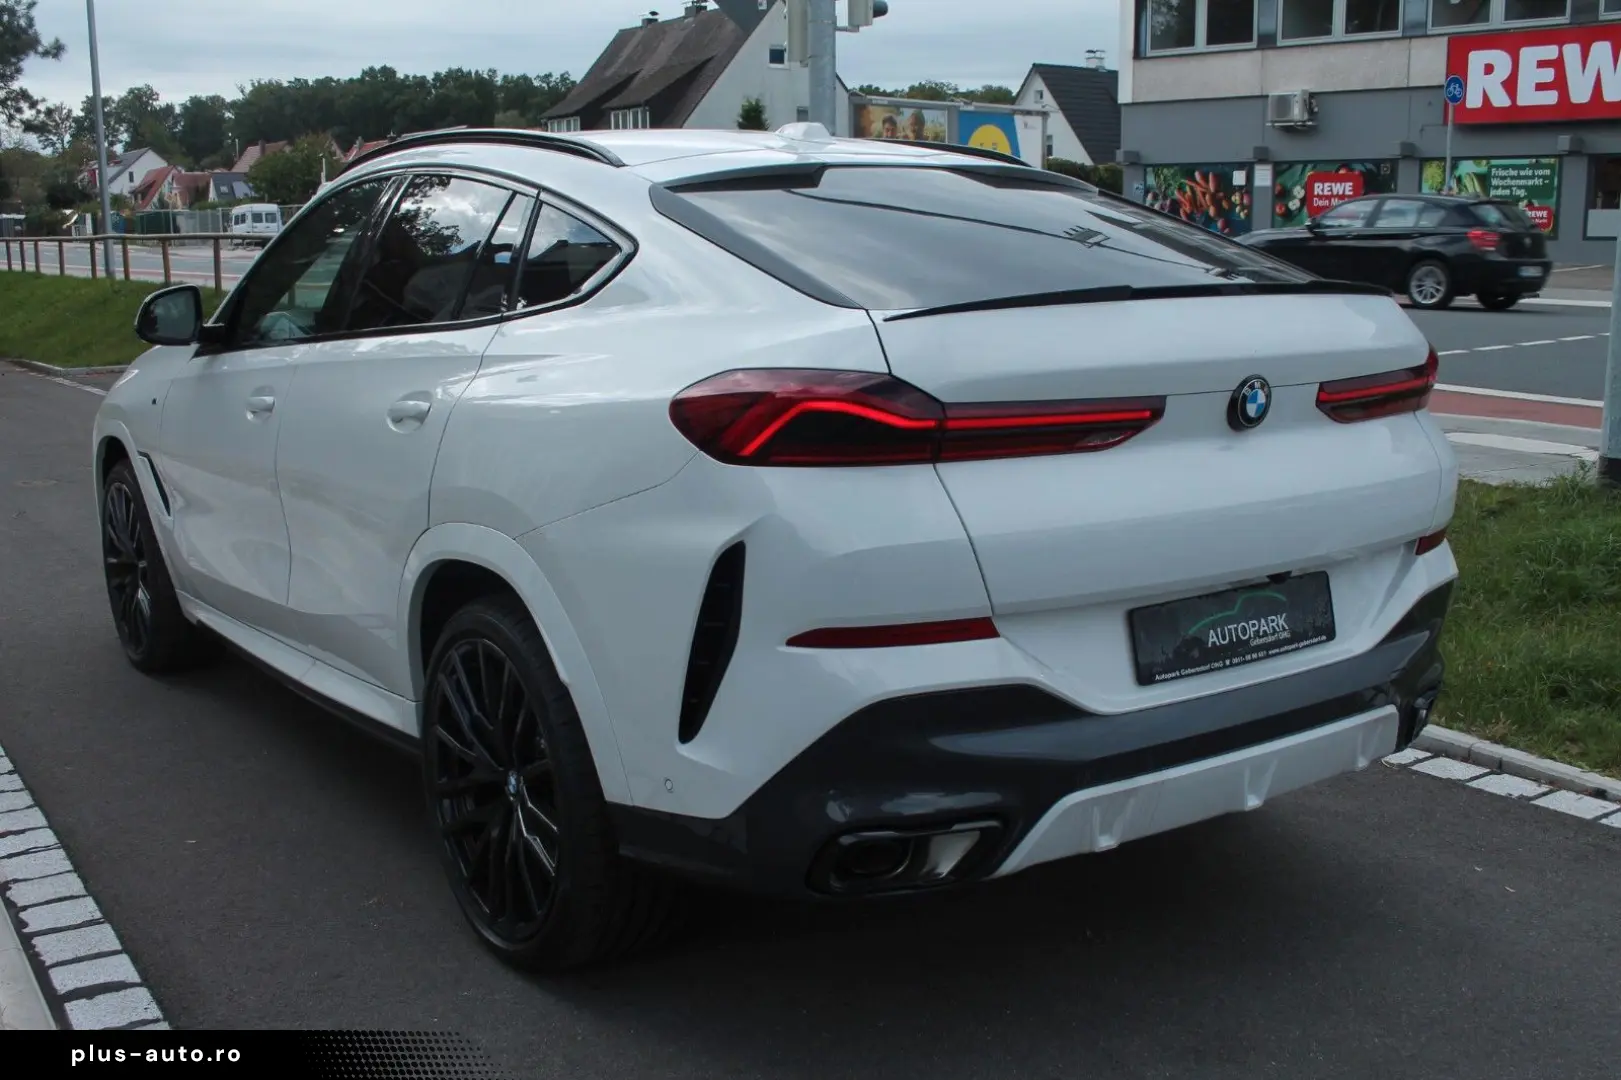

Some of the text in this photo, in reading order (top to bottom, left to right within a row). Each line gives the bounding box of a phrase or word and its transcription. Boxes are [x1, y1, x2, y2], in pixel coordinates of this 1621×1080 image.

[1491, 168, 1518, 176] Frische
[1519, 168, 1533, 176] wie
[1491, 177, 1543, 186] Wochenmarkt
[1313, 182, 1353, 196] REWE
[1490, 187, 1527, 198] jeden Tag.
[1313, 198, 1329, 207] Dein
[1208, 613, 1289, 648] AUTOPARK
[1155, 670, 1181, 681] Autopark
